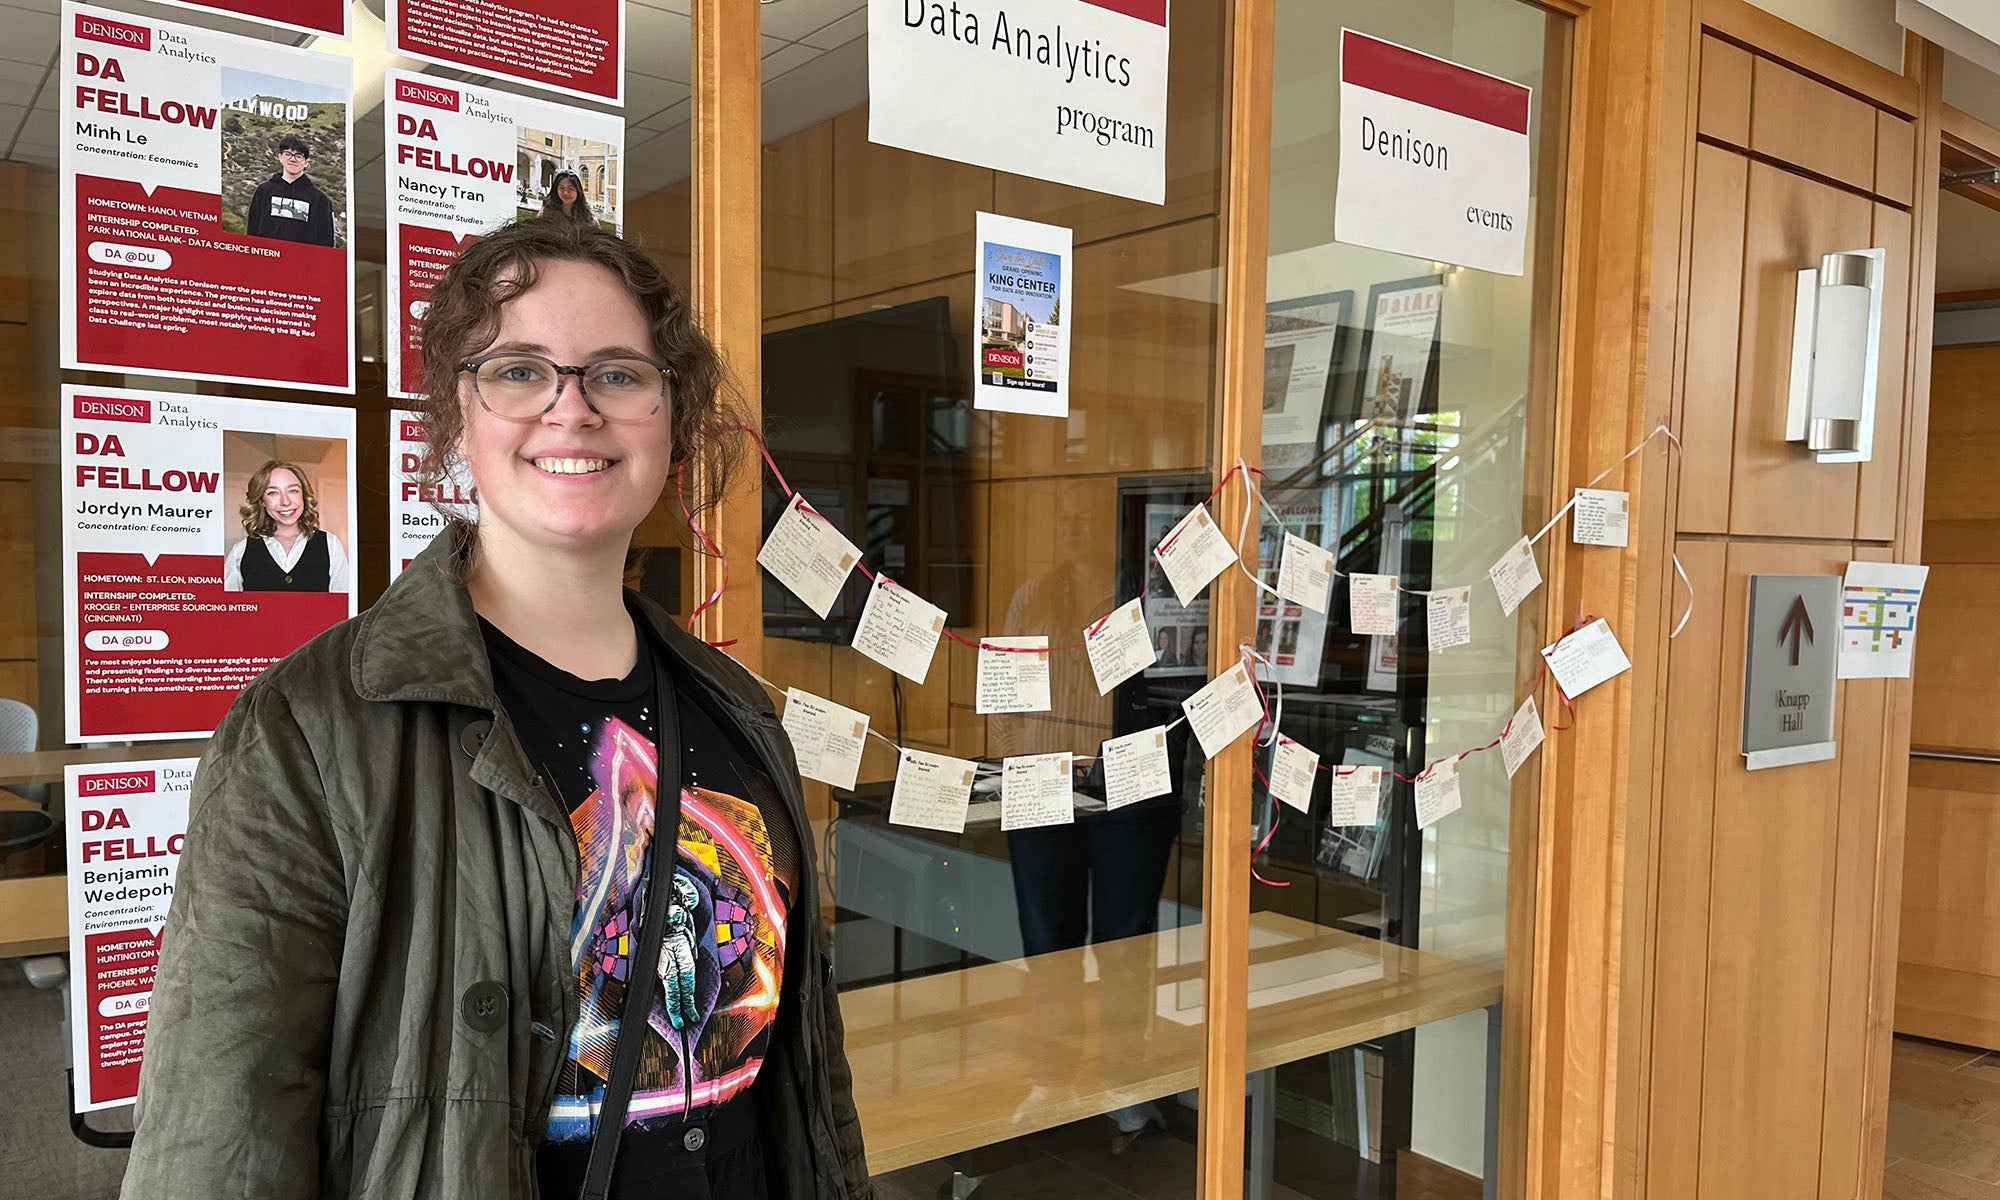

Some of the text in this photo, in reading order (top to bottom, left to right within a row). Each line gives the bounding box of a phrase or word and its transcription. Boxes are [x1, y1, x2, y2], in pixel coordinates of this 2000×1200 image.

[82, 21, 144, 45] DENISON
[158, 29, 187, 45] Data
[408, 34, 437, 46] connects
[438, 41, 459, 52] theory
[467, 48, 493, 60] practice
[506, 57, 518, 65] real
[519, 61, 535, 69] world
[904, 0, 1131, 87] Data Analytics
[157, 44, 216, 65] Analytics
[77, 52, 125, 82] DA
[402, 85, 454, 106] DENISON
[465, 92, 490, 107] Data
[76, 85, 217, 130] FELLOW
[465, 106, 513, 124] Analytics
[76, 121, 148, 145] Minh Le
[397, 113, 438, 141] DA
[1056, 105, 1154, 149] program
[1362, 116, 1449, 171] Denison
[76, 143, 199, 169] Concentration: Economics
[397, 143, 514, 184] FELLOW
[399, 175, 484, 202] Nancy Tran
[88, 197, 147, 212] HOMETOWN:
[179, 210, 218, 222] VIETNAM
[398, 194, 456, 210] Concentration:
[88, 213, 199, 235] INTERNSHIP COMPLETED:
[398, 205, 484, 226] Environmental Studies
[1466, 206, 1513, 232] events
[88, 225, 110, 235] PARK
[112, 229, 157, 241] NATIONAL
[188, 238, 212, 249] DATA
[213, 242, 249, 254] SCIENCE
[251, 247, 280, 258] INTERN
[105, 249, 155, 263] DA @DU
[1002, 265, 1043, 277] GRAND OPENING
[88, 268, 123, 279] Studying
[123, 271, 142, 281] Data
[143, 274, 179, 285] Analytics
[189, 280, 219, 290] Denison
[220, 284, 236, 292] over
[251, 288, 267, 296] past
[268, 290, 287, 298] three
[288, 293, 307, 301] years
[989, 273, 1056, 294] KING CENTER
[1025, 291, 1053, 299] INNOVATION
[88, 316, 189, 334] Data Challenge last spring.
[988, 353, 1020, 365] DENISON
[81, 402, 144, 417] DENISON
[159, 401, 188, 414] Data
[158, 415, 218, 430] Analytics
[76, 433, 126, 457] DA
[76, 465, 220, 493] FELLOW
[77, 501, 213, 519] Jordyn Maurer
[77, 522, 201, 533] Concentration: Economics
[402, 513, 439, 526] Bach
[83, 575, 143, 583] HOMETOWN:
[146, 576, 160, 584] ST.
[161, 576, 186, 585] LEON,
[83, 592, 196, 601] INTERNSHIP COMPLETED:
[83, 603, 121, 611] KROGER
[129, 604, 180, 612] ENTERPRISE
[182, 604, 227, 612] SOURCING
[228, 604, 258, 612] INTERN
[84, 614, 142, 623] (CINCINNATI)
[102, 635, 152, 647] DA @DU
[121, 658, 152, 666] enjoyed
[153, 657, 183, 666] learning
[218, 657, 251, 665] engaging
[101, 668, 143, 676] presenting
[1777, 689, 1810, 710] Knapp
[1781, 713, 1804, 733] Hall
[163, 769, 192, 780] Data
[86, 776, 149, 792] DENISON
[81, 808, 130, 832] DA
[84, 865, 169, 884] Benjamin
[85, 883, 174, 903] Wedepoh
[85, 904, 155, 918] Concentration:
[85, 916, 152, 930] Environmental
[97, 940, 155, 953] HOMETOWN:
[97, 950, 154, 963] HUNTINGTON
[97, 966, 149, 979] INTERNSHIP
[115, 1000, 132, 1010] DA
[100, 1050, 127, 1058] faculty
[101, 1056, 142, 1067] throughout
